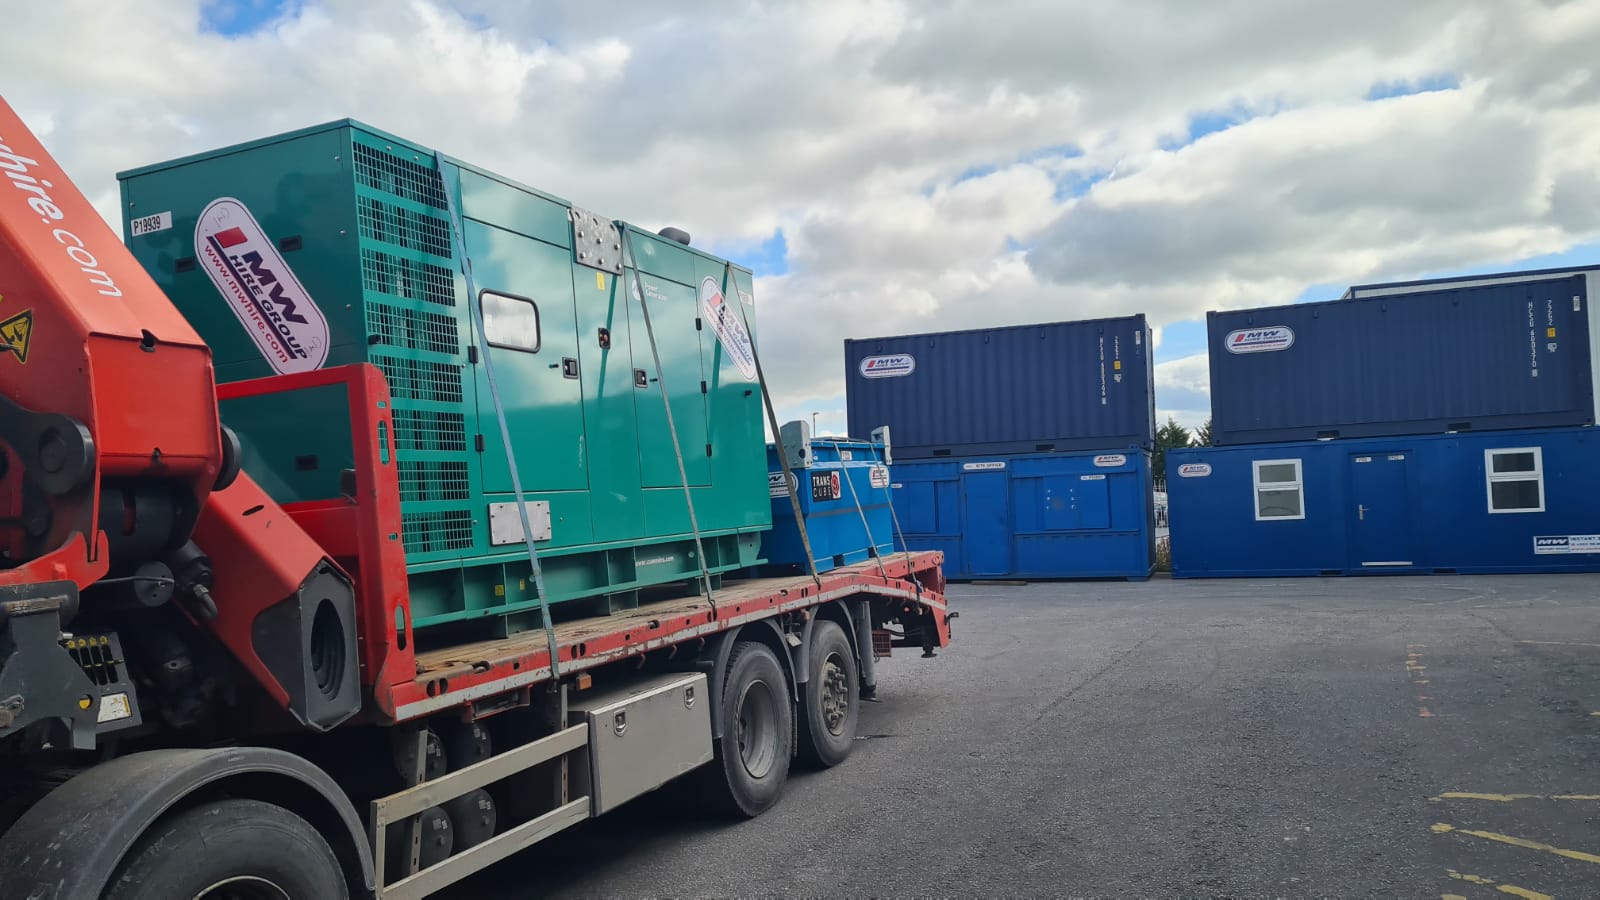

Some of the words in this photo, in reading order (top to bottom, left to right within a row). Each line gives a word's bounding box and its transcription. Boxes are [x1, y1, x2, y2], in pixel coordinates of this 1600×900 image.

[133, 215, 160, 235] P19939
[241, 250, 309, 325] MW
[204, 245, 288, 363] www.mwhire.com
[229, 255, 264, 296] HIRE
[261, 299, 307, 359] GROUP
[1247, 330, 1280, 338] MW
[812, 475, 831, 484] TRANS
[812, 487, 831, 498] CUBE
